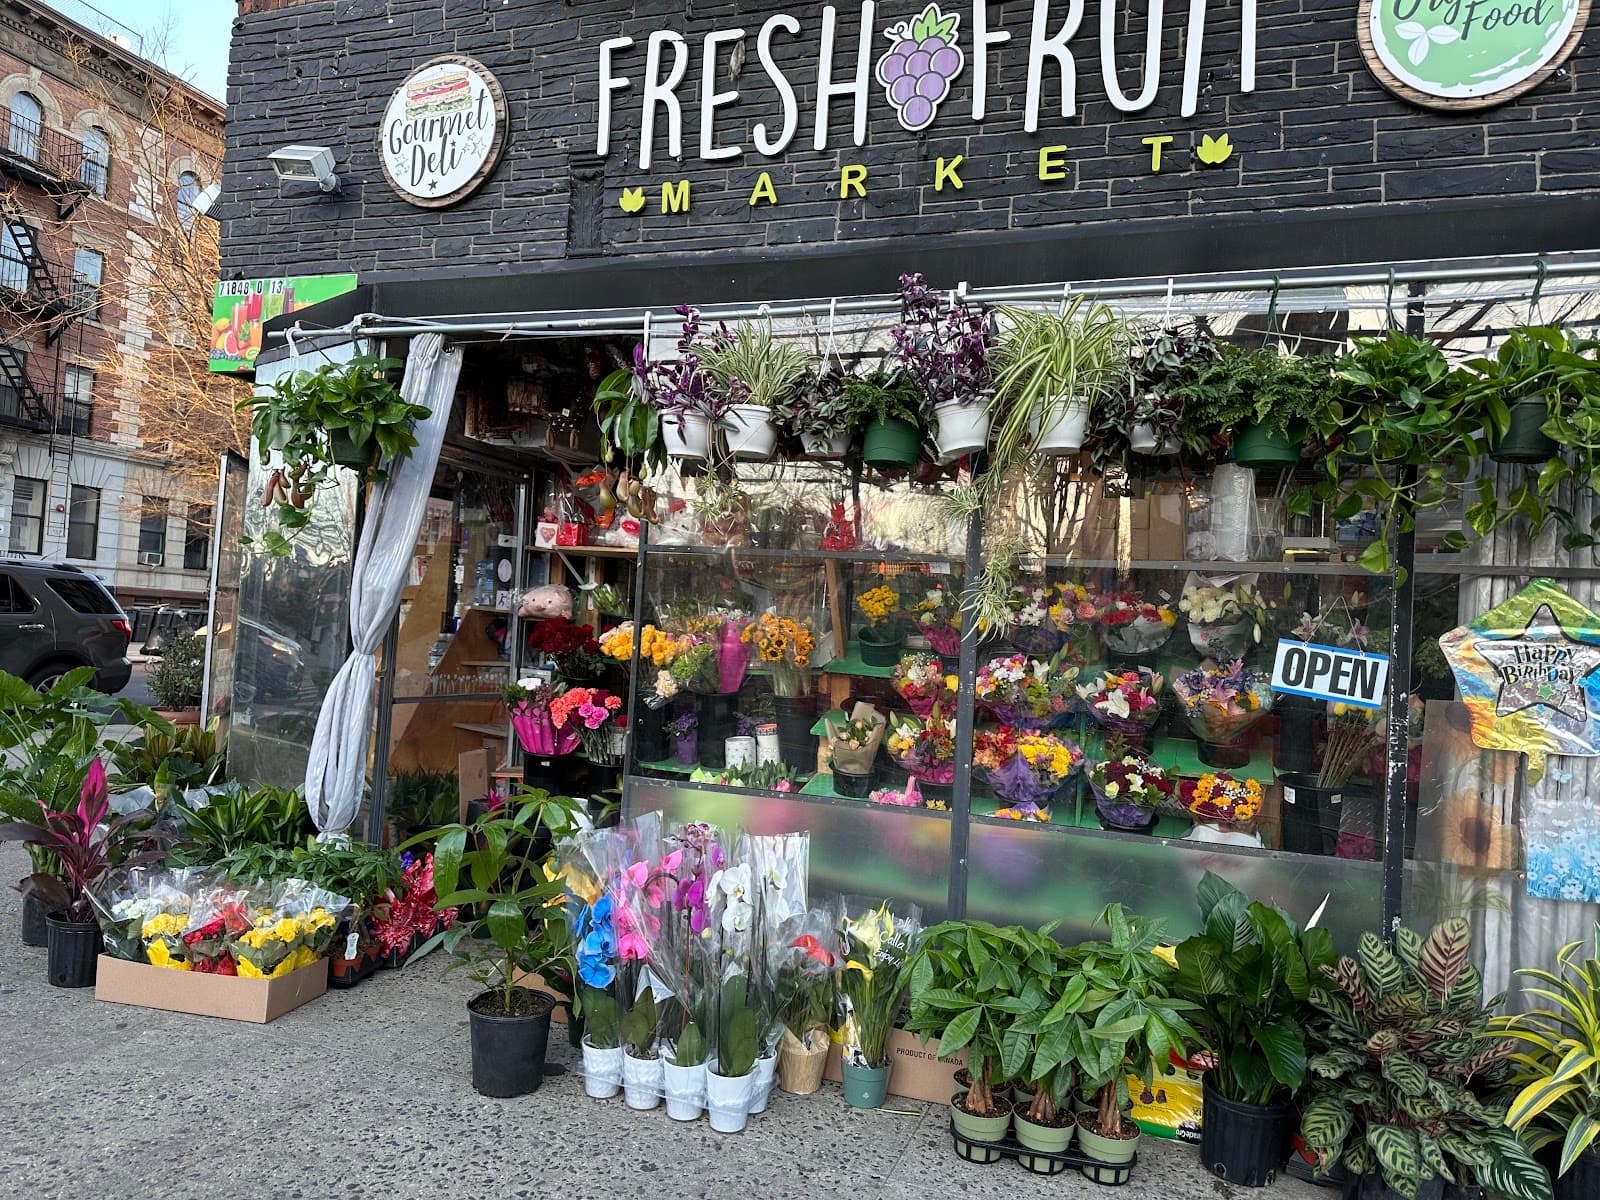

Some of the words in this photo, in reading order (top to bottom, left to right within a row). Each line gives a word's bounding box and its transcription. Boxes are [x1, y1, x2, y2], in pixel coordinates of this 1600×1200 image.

[1461, 0, 1553, 40] Food
[597, 0, 875, 169] FRESH
[389, 89, 488, 155] Gourmet
[411, 133, 463, 187] Deli
[661, 134, 1174, 214] MARKET
[1281, 647, 1379, 700] OPEN
[896, 1047, 926, 1059] PRODUCT
[927, 1053, 937, 1061] OF
